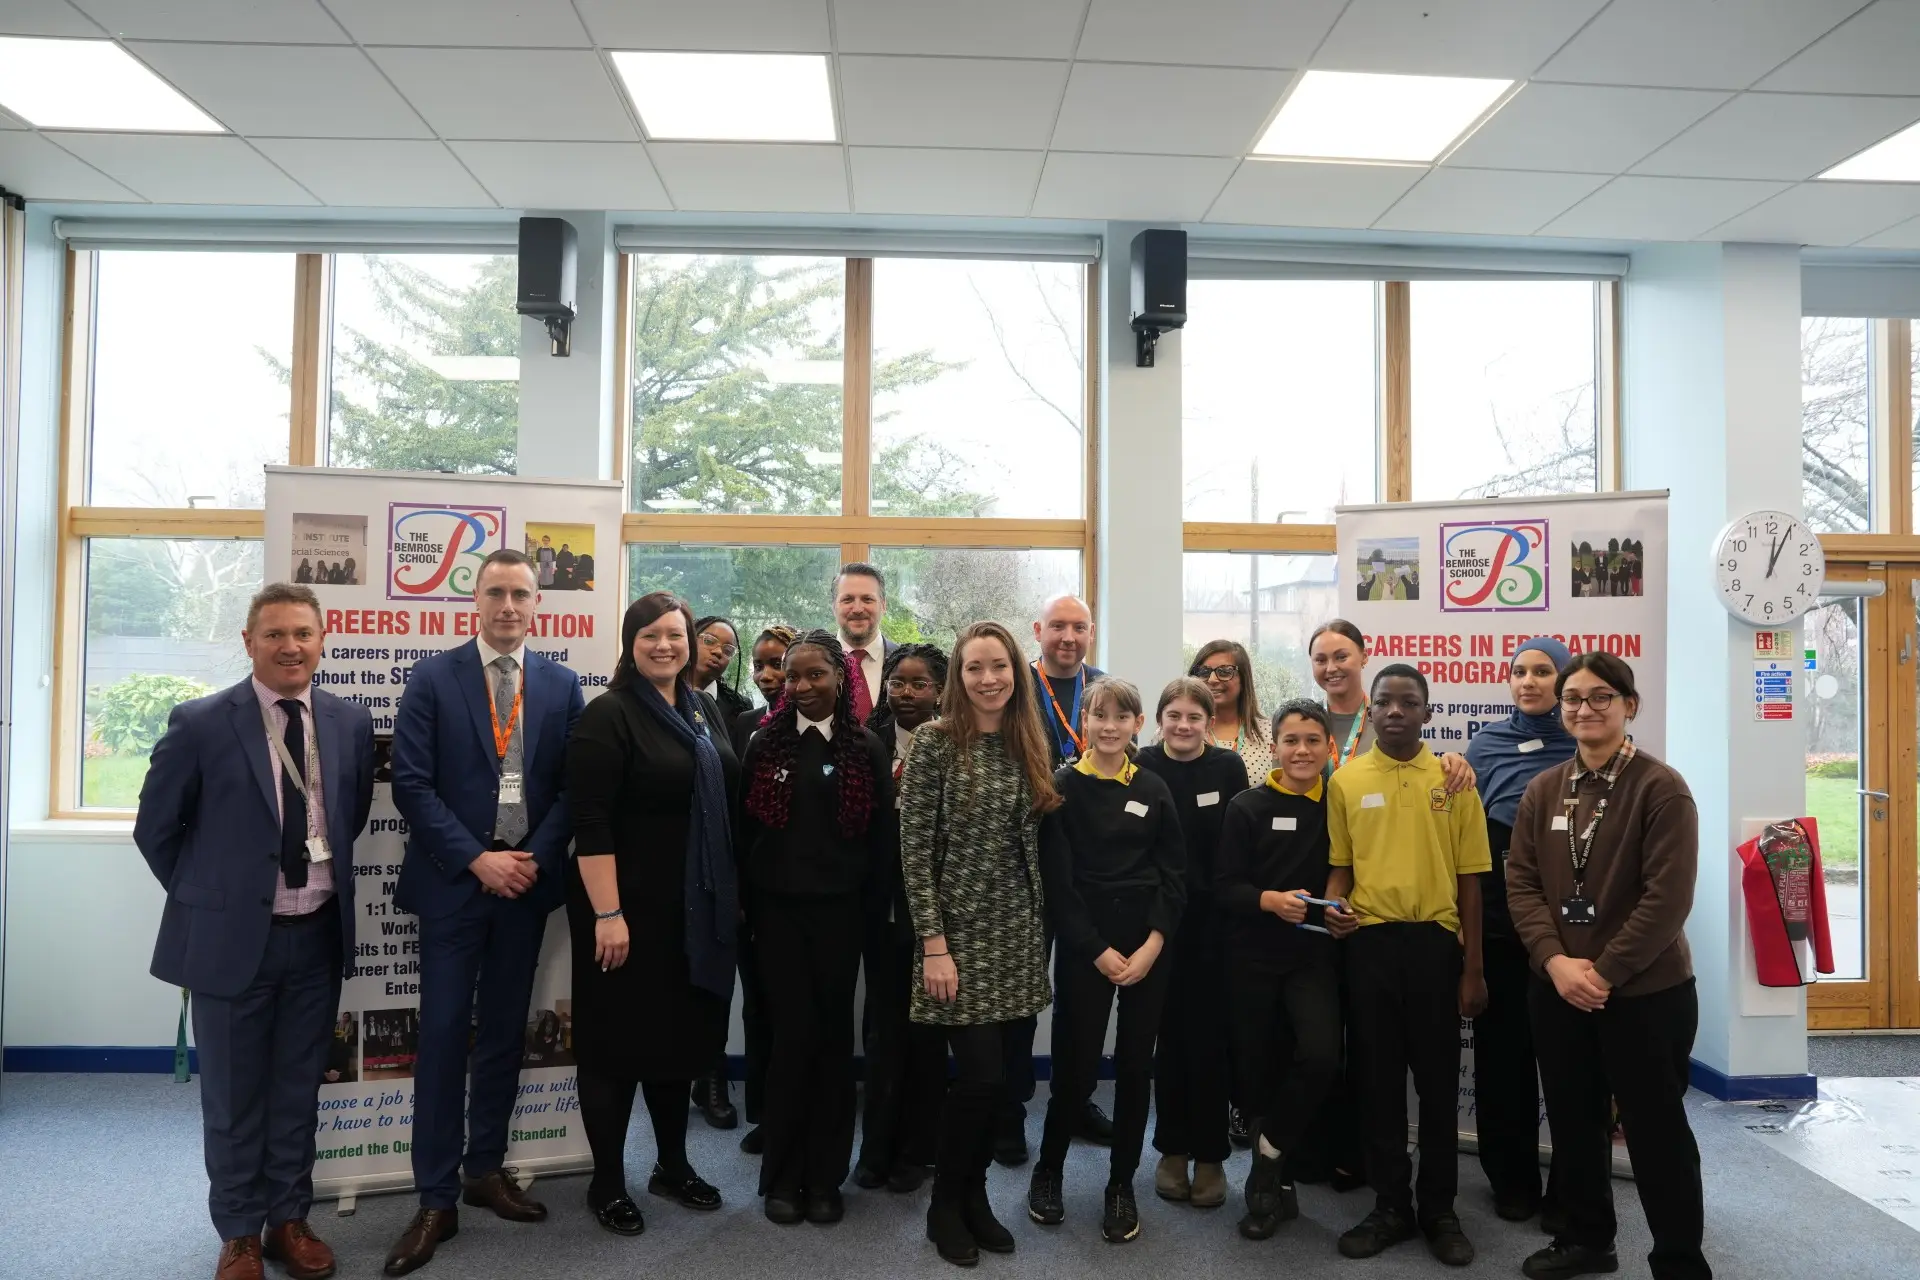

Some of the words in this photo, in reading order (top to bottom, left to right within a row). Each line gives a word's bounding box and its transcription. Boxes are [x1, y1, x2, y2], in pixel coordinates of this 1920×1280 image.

[1748, 526, 1757, 538] 11
[1765, 521, 1778, 535] 12
[304, 533, 350, 543] INSTUTE
[408, 532, 429, 542] THE
[313, 548, 350, 557] Sciences
[394, 542, 443, 554] BEMROSE
[1732, 540, 1747, 552] 10
[1799, 543, 1809, 556] 2
[398, 553, 439, 564] SCHOOL
[1459, 549, 1476, 558] THE
[1445, 558, 1490, 568] BEMROSE
[1727, 559, 1737, 571] 9
[1450, 568, 1486, 578] SCHOOL
[1802, 564, 1812, 576] 3
[1731, 579, 1741, 592] 8
[1796, 582, 1805, 595] 4
[1745, 594, 1754, 607] 7
[1783, 596, 1793, 609] 5
[1763, 601, 1773, 614] 6
[419, 611, 445, 636] IN
[454, 611, 594, 638] EDATION
[1363, 634, 1462, 658] CAREERS
[1470, 634, 1493, 657] IN
[1502, 633, 1642, 658] EATION
[331, 647, 390, 660] careers
[361, 671, 386, 685] the
[1440, 727, 1462, 740] the
[366, 902, 387, 916] 1:1
[381, 921, 418, 936] Work
[383, 942, 398, 956] to
[363, 1096, 374, 1108] a
[376, 1089, 404, 1111] job
[516, 1083, 544, 1099] you
[549, 1076, 578, 1092] will
[331, 1115, 372, 1131] have
[378, 1114, 393, 1127] to
[514, 1101, 552, 1119] your
[554, 1095, 580, 1113] life
[367, 1142, 389, 1155] the
[511, 1125, 567, 1142] Standard
